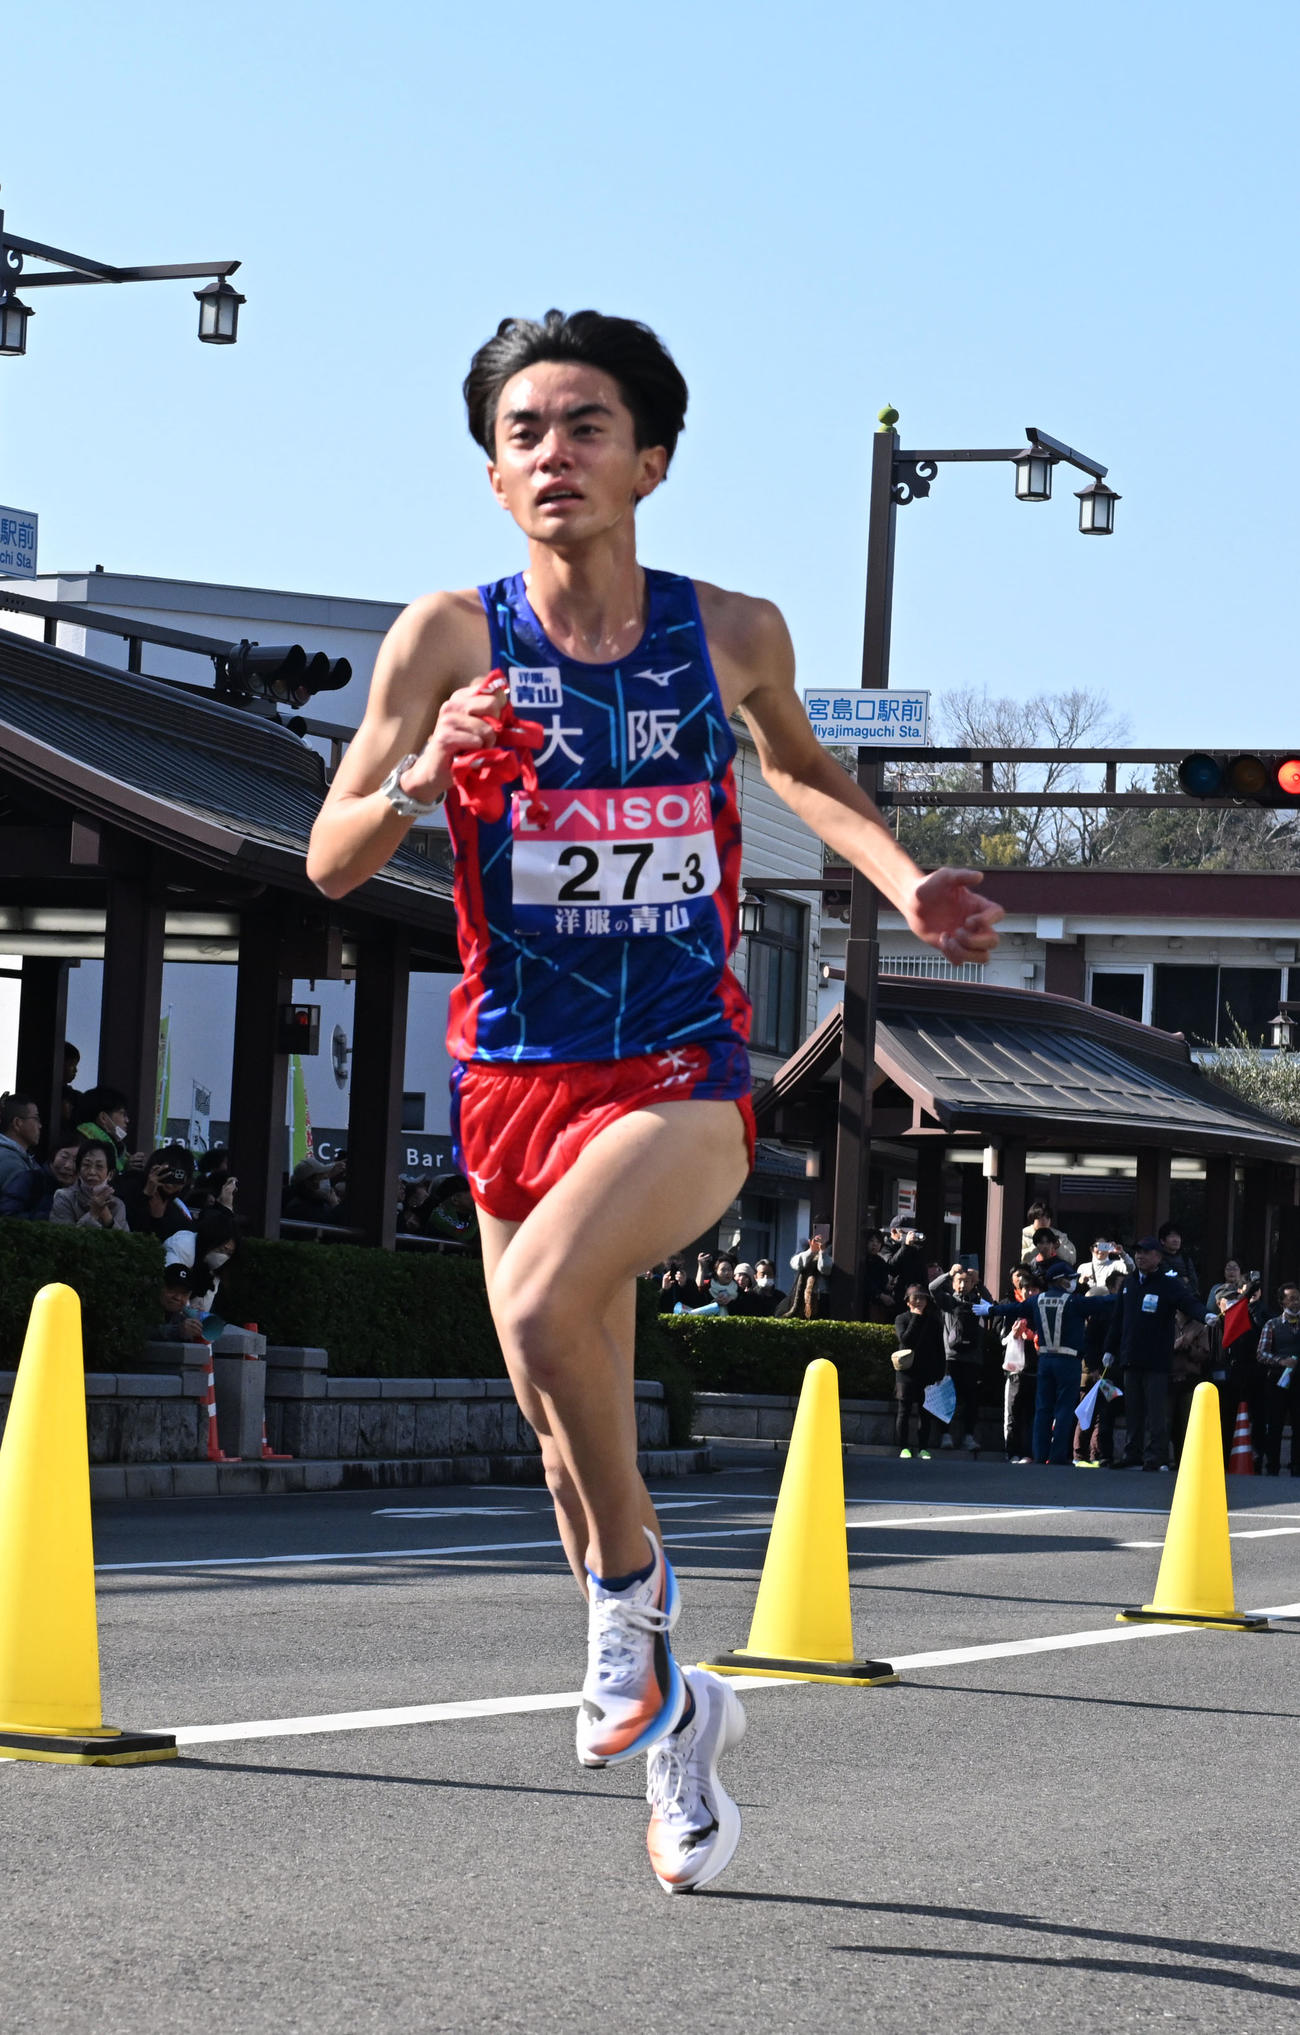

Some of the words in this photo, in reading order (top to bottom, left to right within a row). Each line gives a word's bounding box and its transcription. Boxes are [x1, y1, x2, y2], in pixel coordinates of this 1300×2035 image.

[16, 552, 33, 569] Sta.
[515, 685, 559, 703] 青山
[808, 698, 923, 722] 宮島口駅前
[533, 709, 680, 765] 大阪
[898, 725, 922, 738] Sta.
[557, 843, 705, 901] 27-3
[554, 904, 690, 935] 洋服の青山
[406, 1148, 444, 1168] Bar
